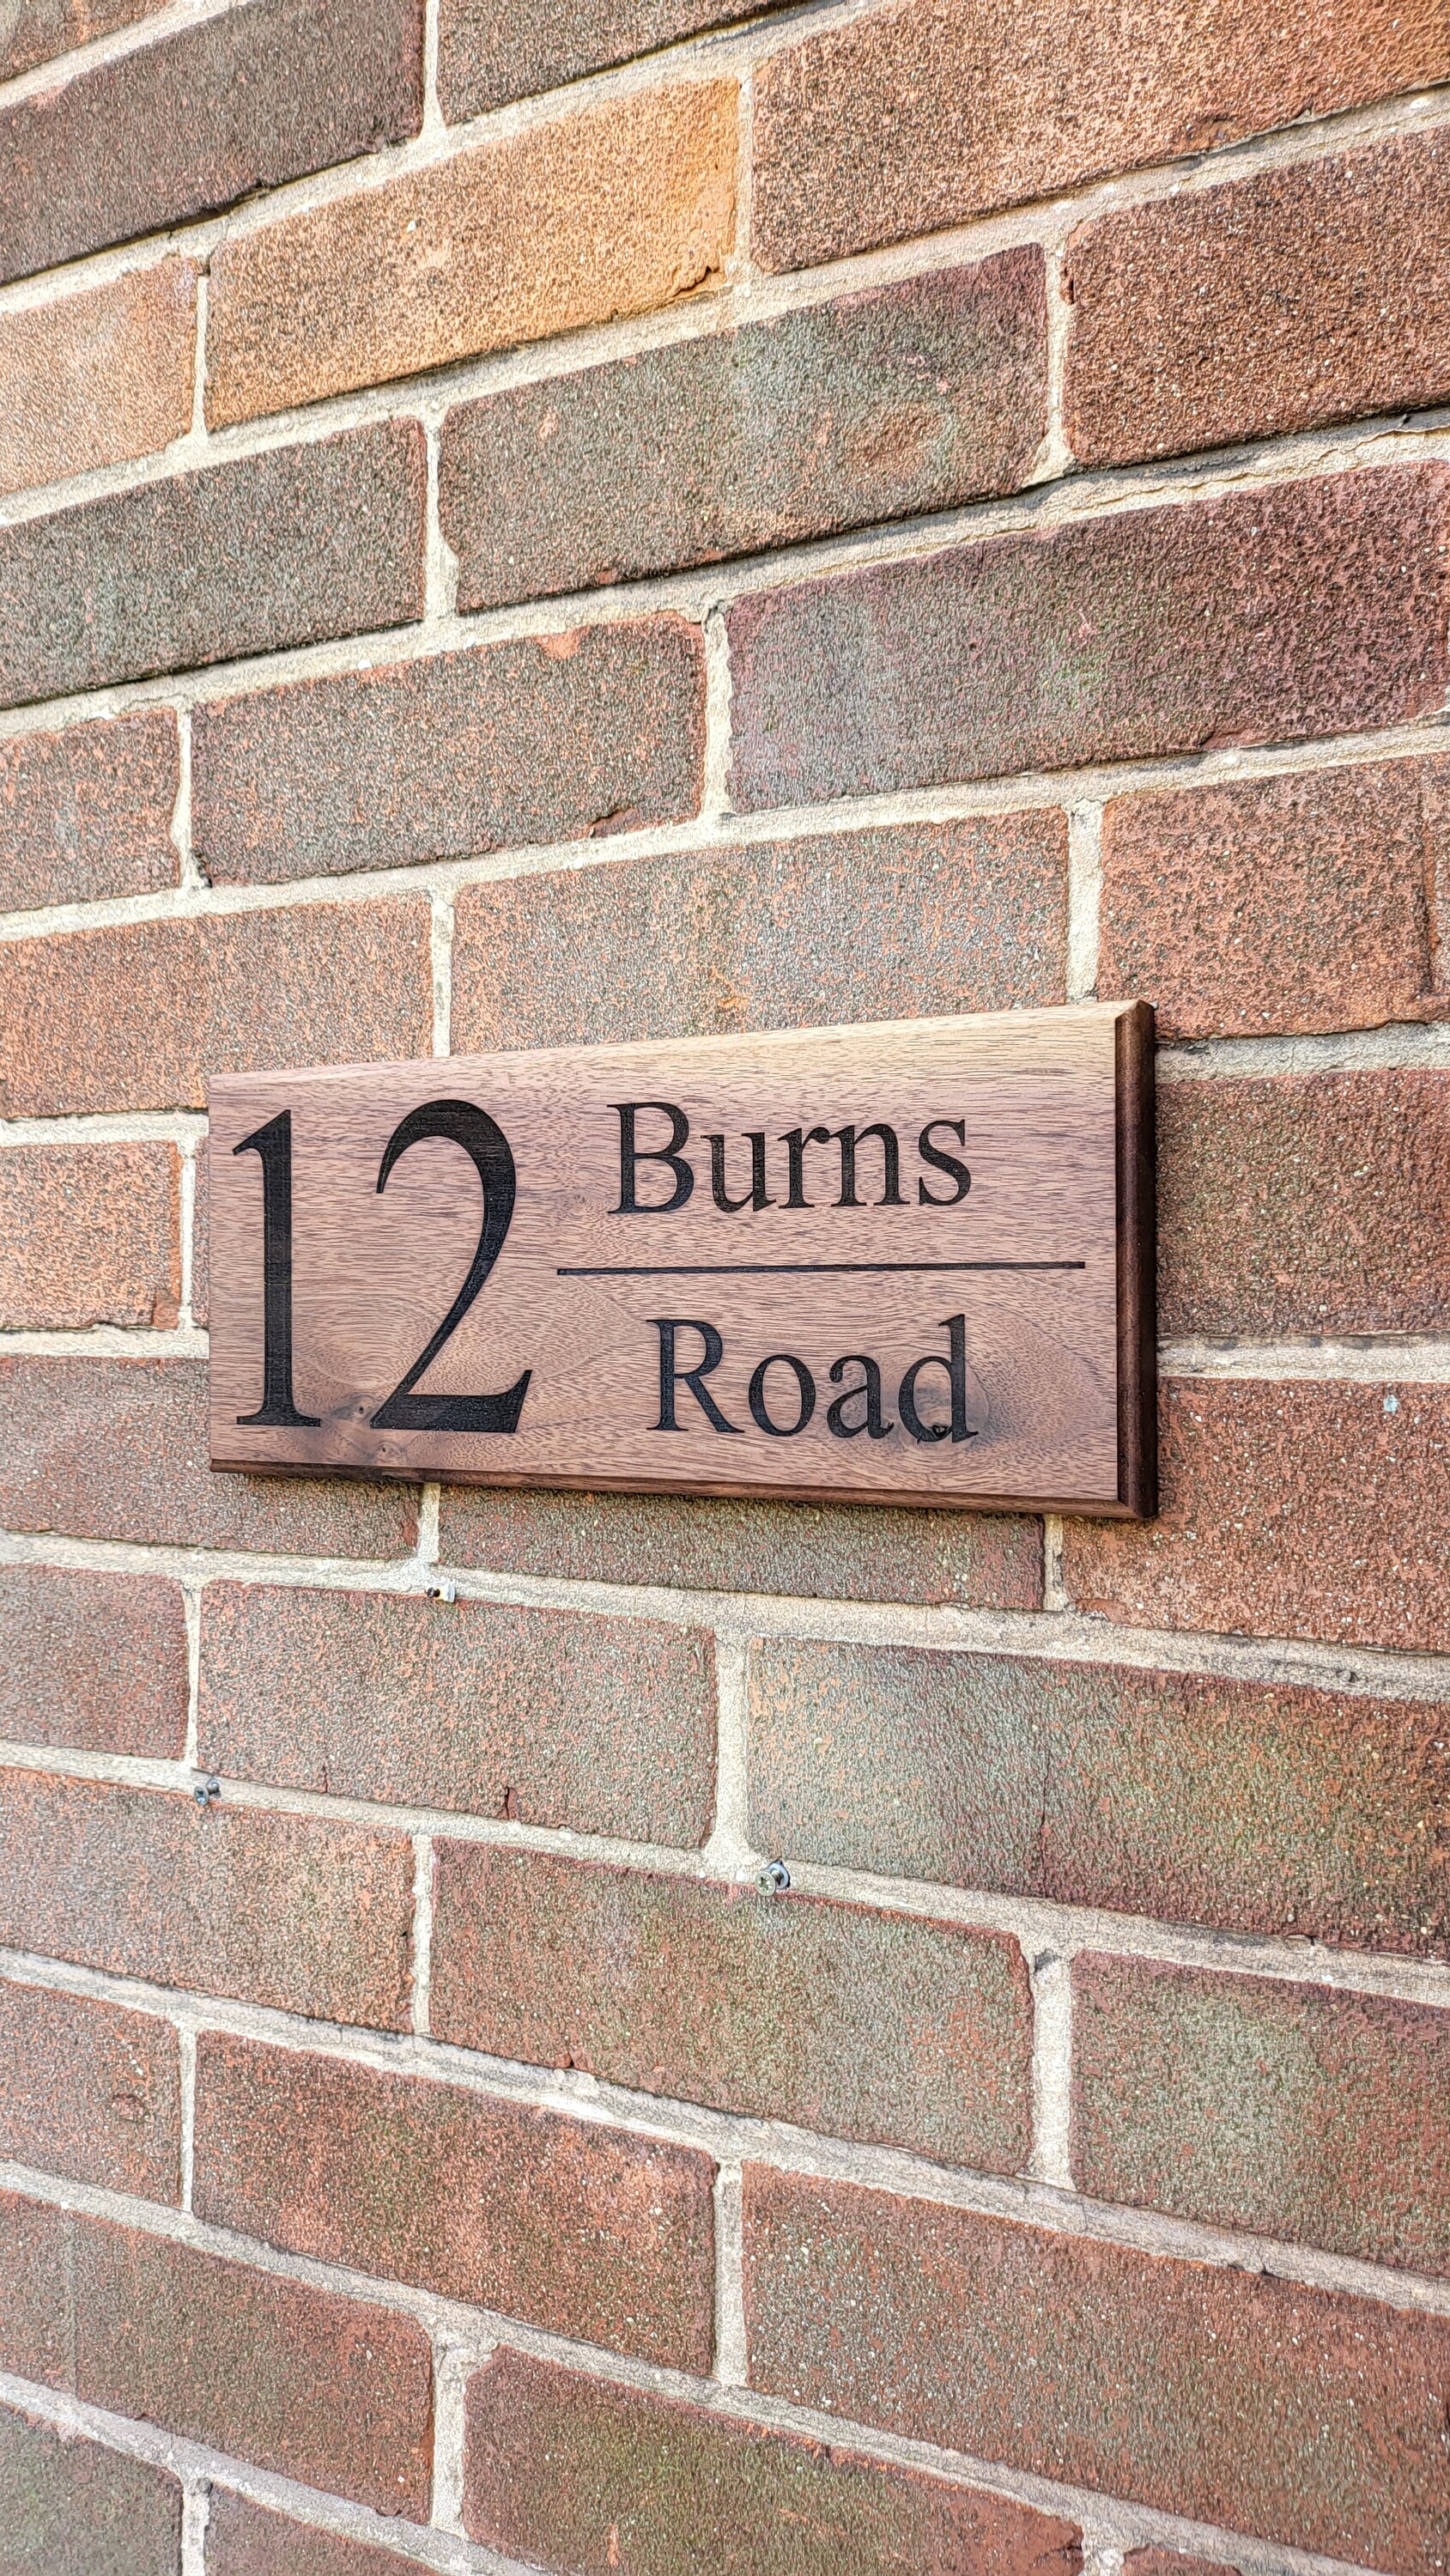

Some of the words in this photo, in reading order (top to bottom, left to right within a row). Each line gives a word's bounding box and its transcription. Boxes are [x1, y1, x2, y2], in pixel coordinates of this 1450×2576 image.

[607, 1102, 972, 1214] Burns
[232, 1098, 532, 1433] 12
[646, 1313, 980, 1443] Road
